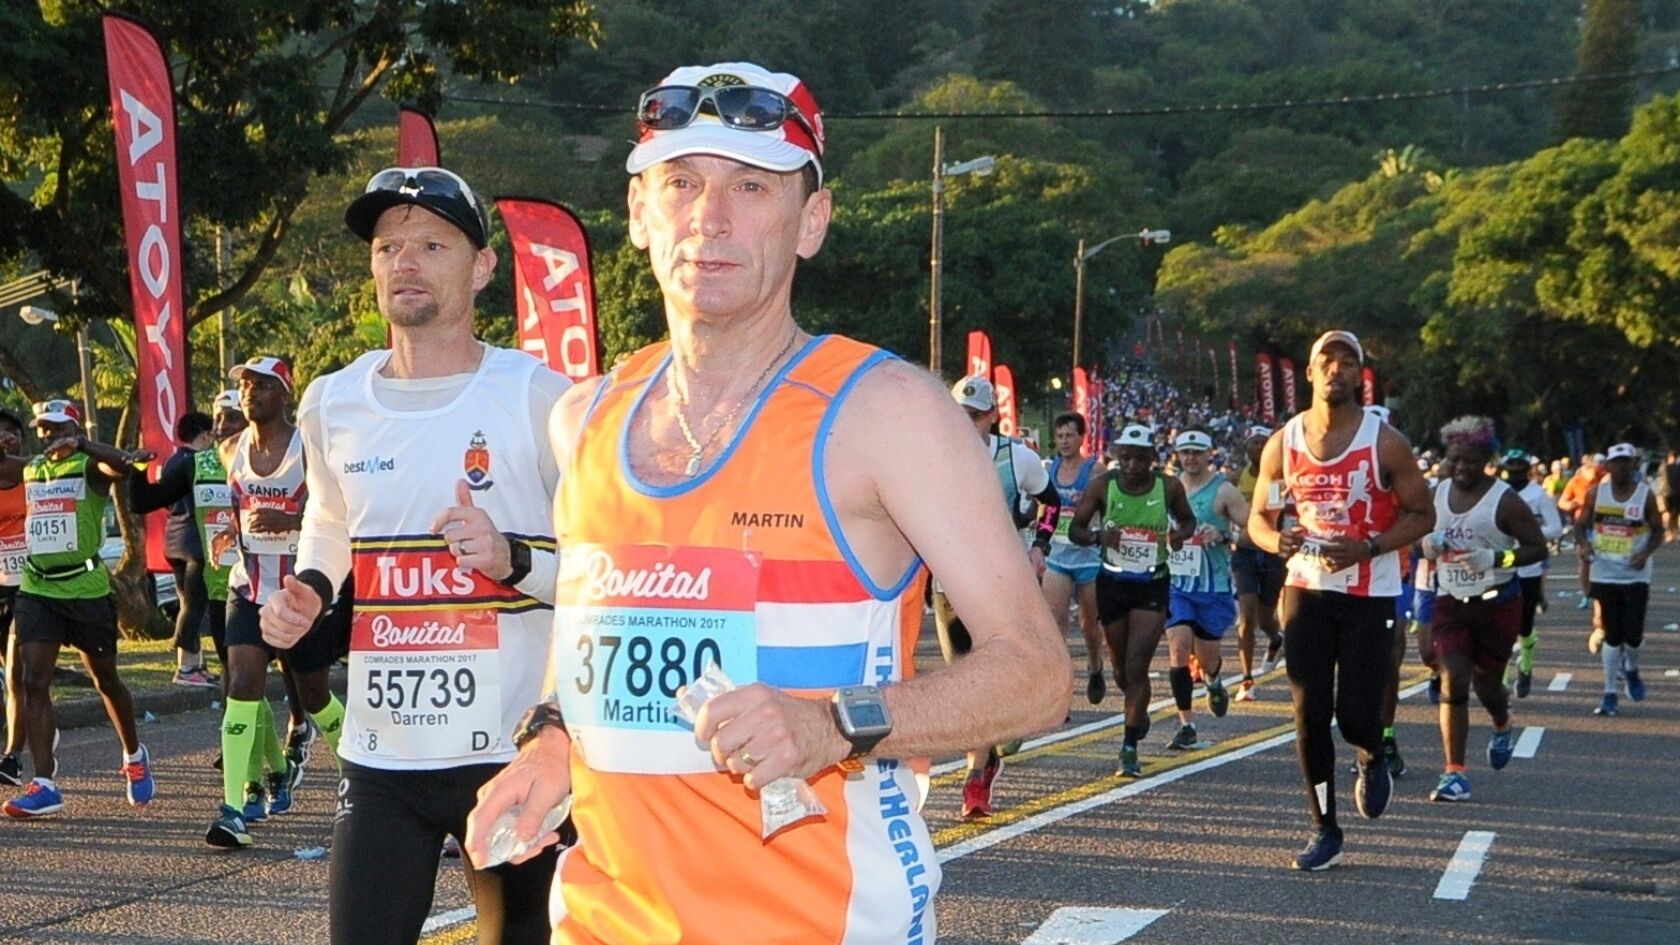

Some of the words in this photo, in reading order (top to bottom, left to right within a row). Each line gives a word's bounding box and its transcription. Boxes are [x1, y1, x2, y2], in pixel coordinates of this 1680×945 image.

[119, 88, 178, 481] ATOYO
[343, 456, 395, 473] bestMed
[29, 519, 67, 536] 40151
[731, 511, 804, 528] MARTIN
[66, 541, 74, 551] C
[376, 555, 476, 597] Tuks
[585, 550, 712, 600] Bonitas
[371, 614, 466, 647] Bonitas
[628, 616, 696, 628] MARATHON
[699, 618, 726, 630] 2017
[363, 654, 405, 664] COMRADES
[406, 653, 455, 663] MARATHON
[457, 653, 478, 663] 2017
[575, 633, 722, 699] 37880
[366, 667, 477, 710] 55739
[391, 710, 449, 726] Darren
[368, 732, 378, 752] 8
[471, 730, 491, 752] D
